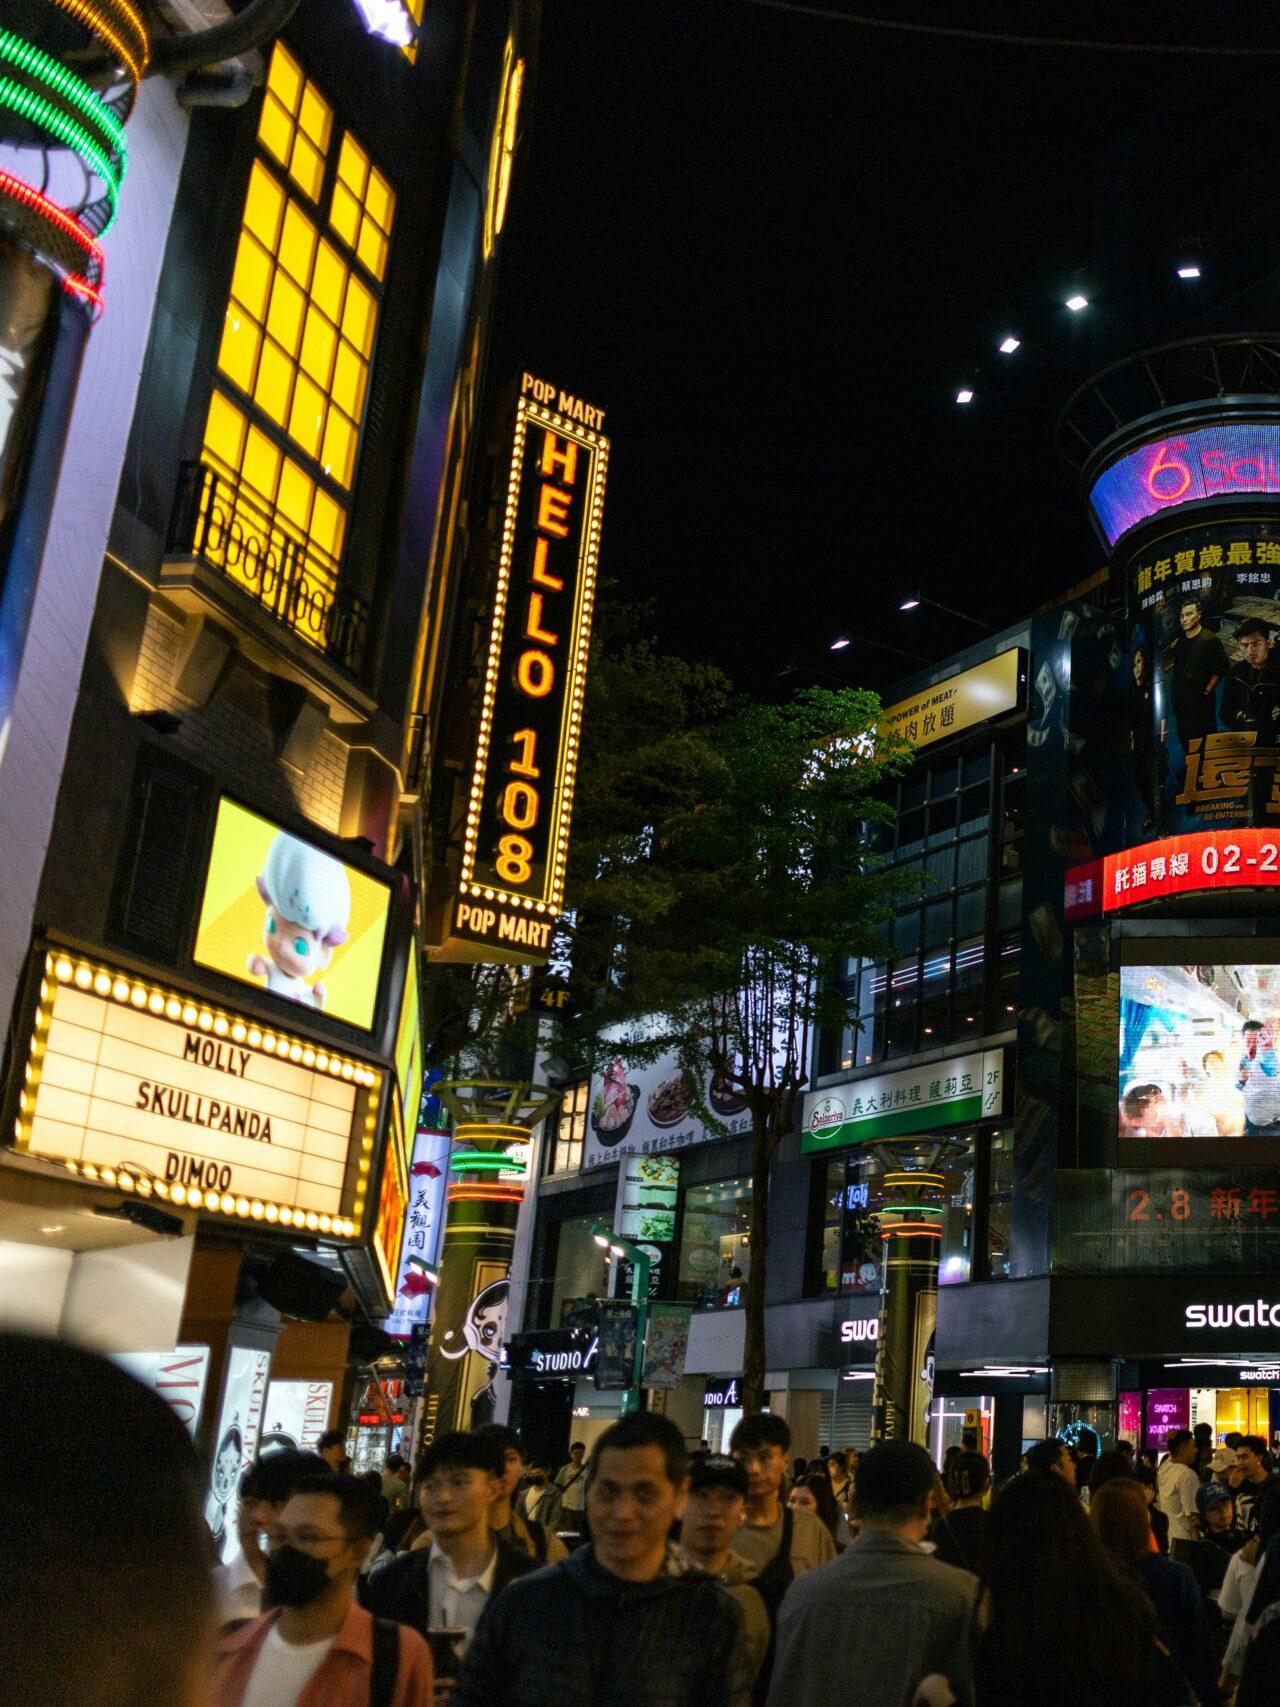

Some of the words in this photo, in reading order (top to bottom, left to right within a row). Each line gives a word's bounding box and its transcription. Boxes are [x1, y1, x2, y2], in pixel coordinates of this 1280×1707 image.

[522, 371, 557, 405] POP
[558, 391, 606, 431] MART
[517, 430, 578, 698] HELLO
[891, 704, 920, 724] POWER
[921, 701, 931, 712] of
[931, 687, 954, 707] MEAT
[495, 727, 542, 884] 108
[456, 902, 496, 935] POP
[497, 913, 552, 949] MART
[184, 1032, 253, 1079] MOLLY
[986, 1070, 1000, 1085] 2F
[135, 1080, 274, 1144] SKULLPANDA
[851, 1084, 922, 1115] 義大利料理
[164, 1151, 233, 1191] DIMOO
[1129, 1188, 1191, 1222] 2.8
[536, 1351, 582, 1372] STUDIO
[1239, 1369, 1280, 1381] swatch
